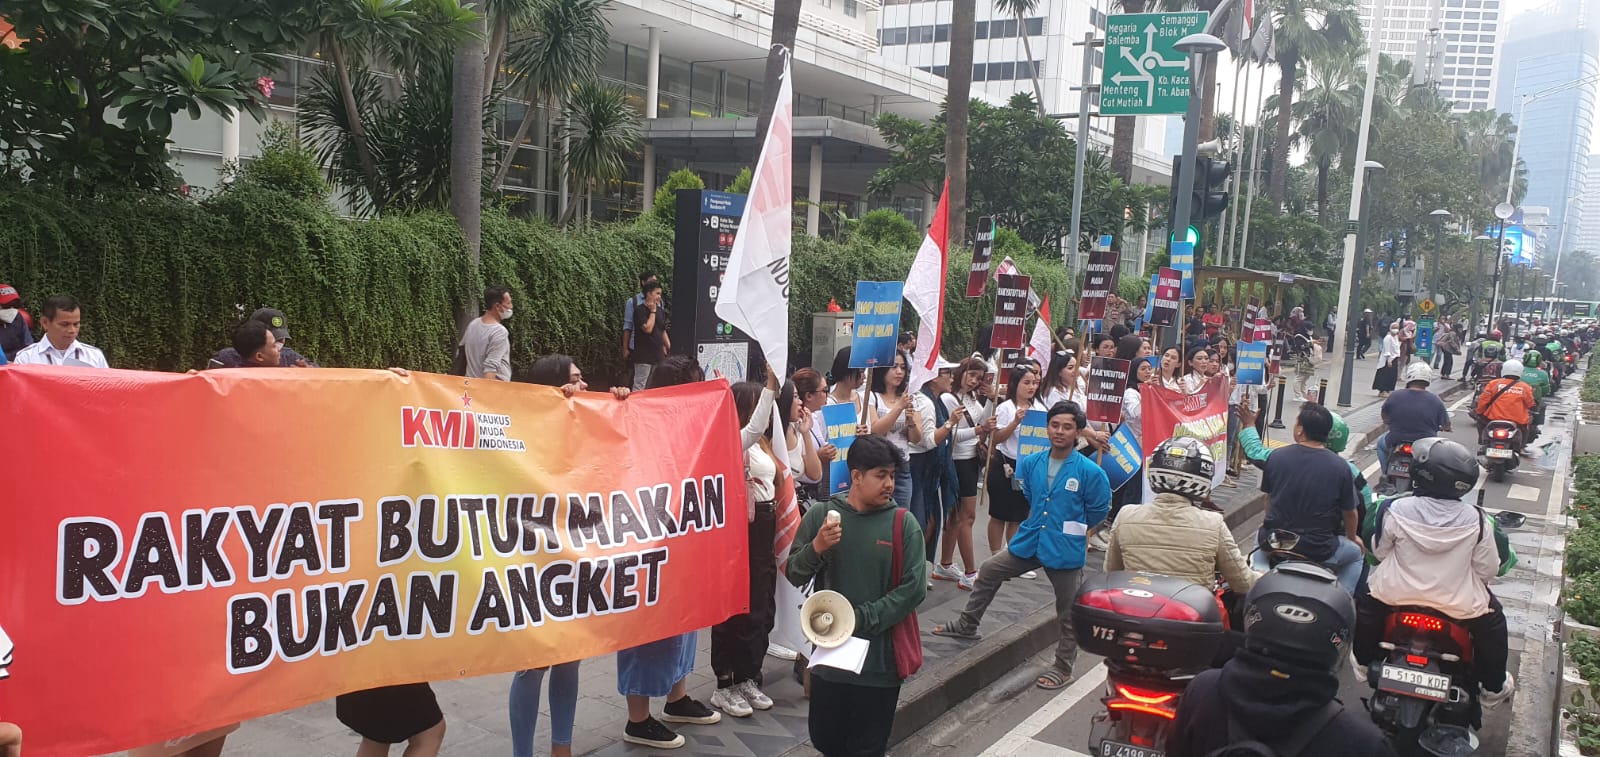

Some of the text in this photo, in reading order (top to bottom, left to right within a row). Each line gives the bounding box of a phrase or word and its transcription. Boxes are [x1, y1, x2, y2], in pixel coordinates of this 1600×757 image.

[1161, 15, 1199, 27] Semanggi
[1108, 23, 1137, 35] Megaria
[1160, 27, 1188, 37] Blok M
[1107, 35, 1140, 45] Salemba
[1171, 76, 1190, 85] Kaca
[1103, 86, 1139, 97] Menteng
[1158, 87, 1190, 97] Tn. Aban
[1102, 97, 1143, 107] Cut Mutiah
[477, 414, 510, 426] KAUKUS
[402, 408, 475, 448] KMI
[480, 426, 505, 437] MUDA
[479, 438, 525, 450] INDONESIA
[61, 474, 725, 600] RAKYAT BUTUH MAKAN
[230, 549, 669, 670] BUKAN ANGKET
[1397, 671, 1423, 685] 5130
[1104, 744, 1111, 756] B
